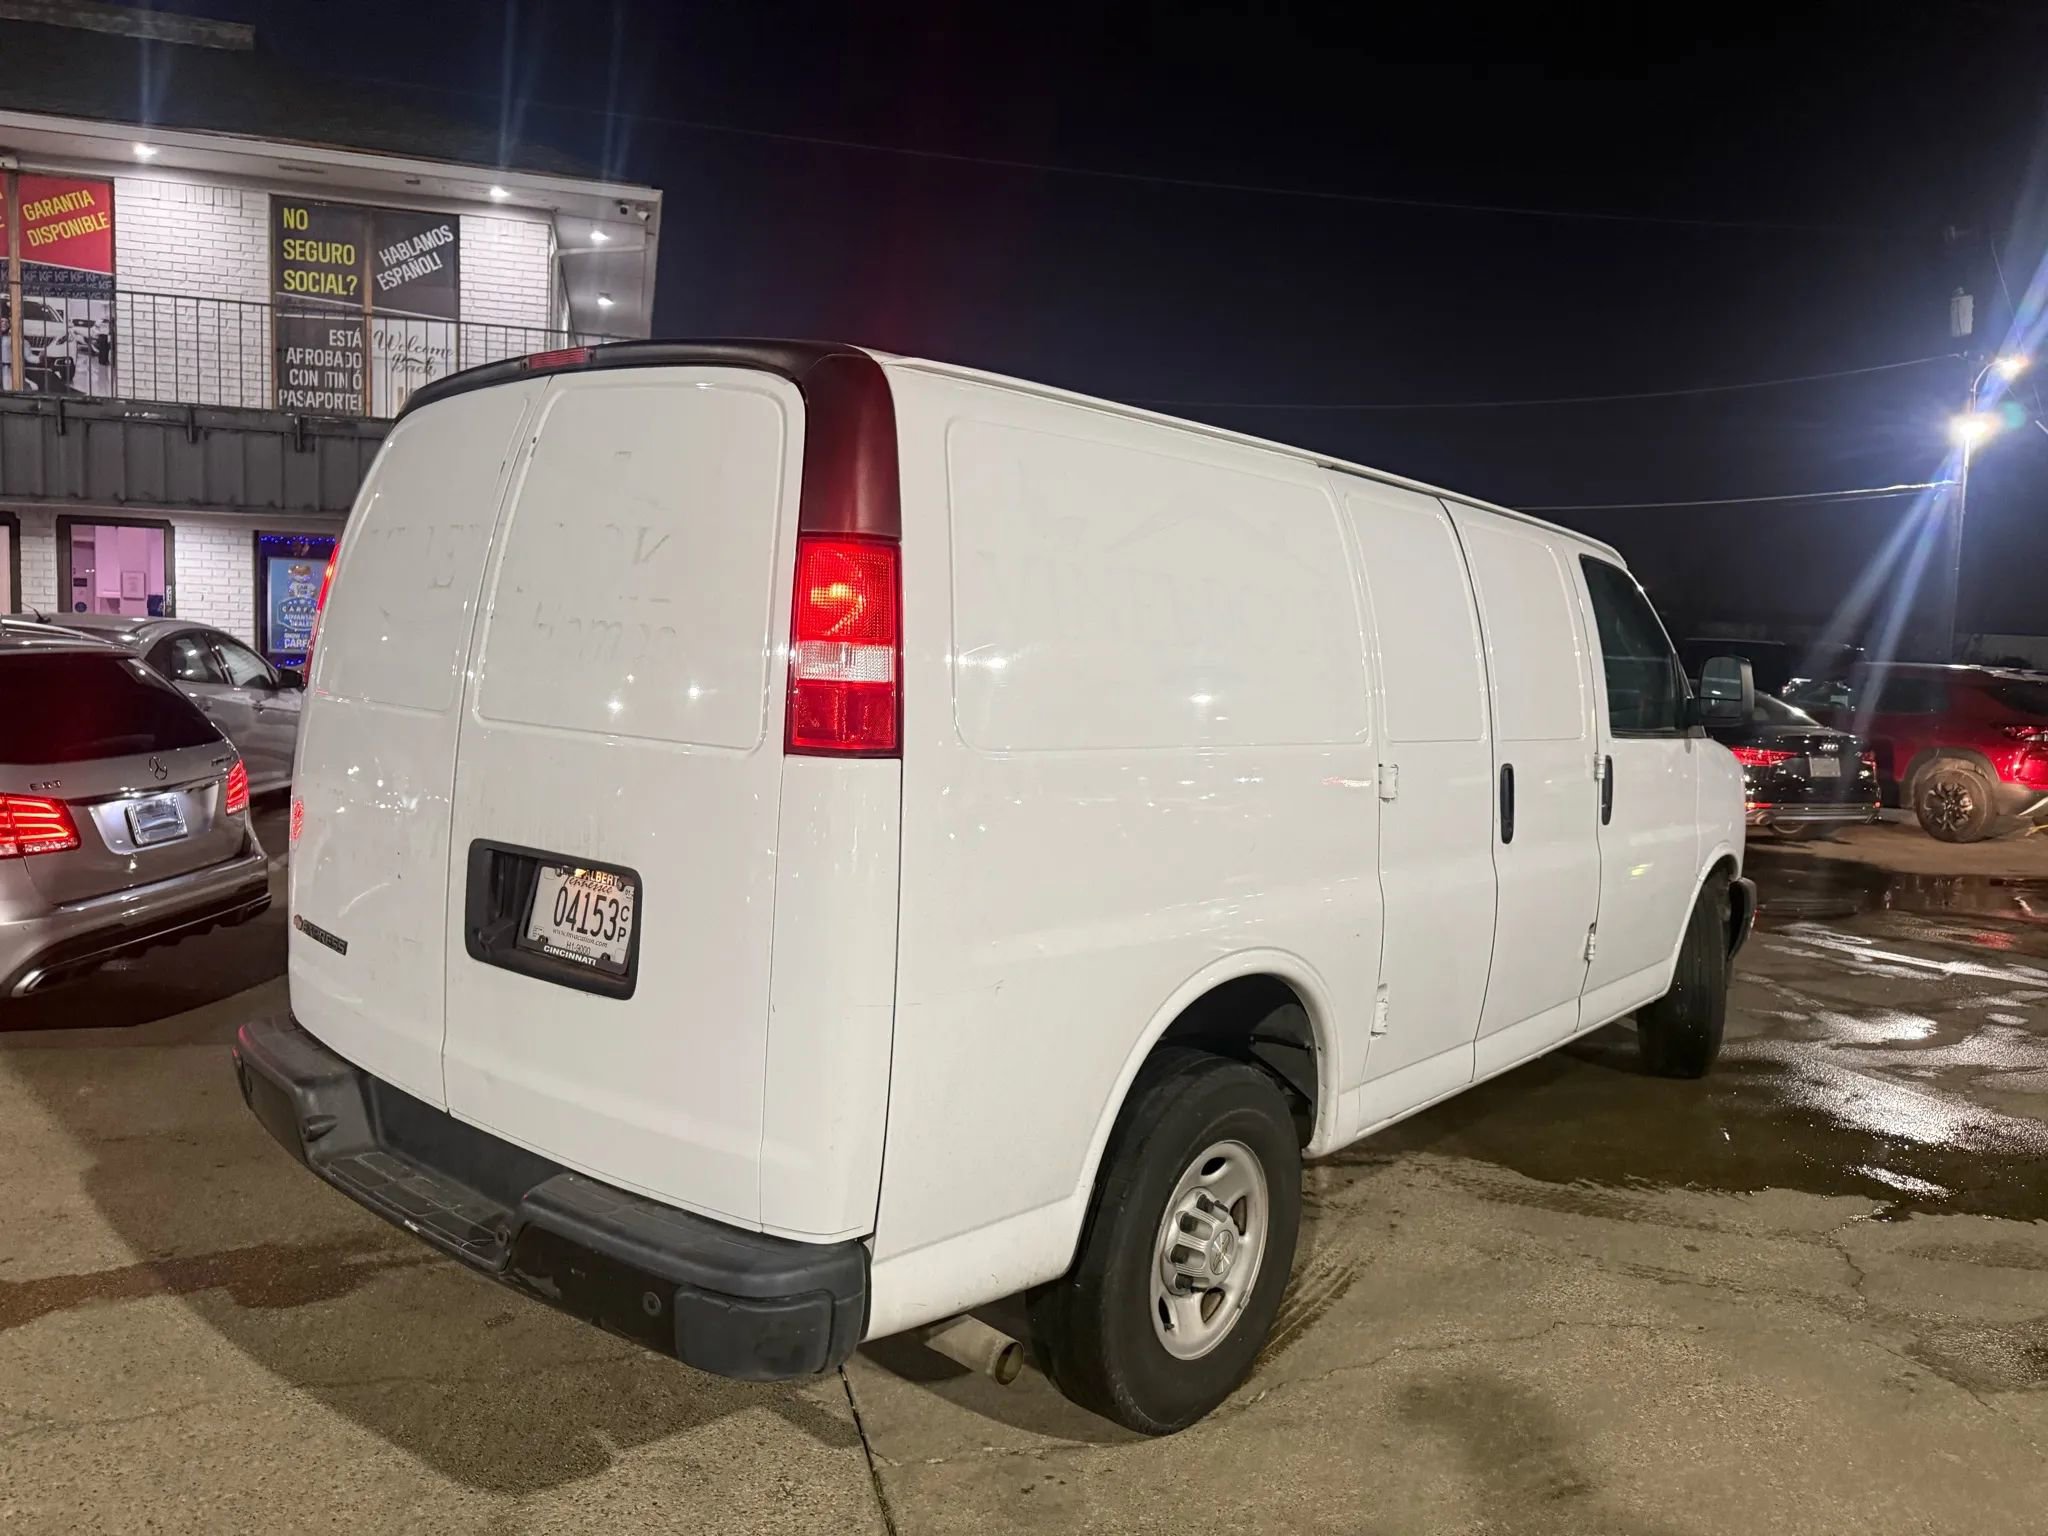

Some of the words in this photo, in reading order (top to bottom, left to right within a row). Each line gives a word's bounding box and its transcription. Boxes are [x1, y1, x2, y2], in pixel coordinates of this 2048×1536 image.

[22, 189, 95, 221] GARANTIA
[26, 212, 110, 247] DISPONIBLE
[283, 207, 308, 230] NO
[283, 238, 356, 266] SEGURO
[378, 225, 454, 267] HABLAMOS
[283, 269, 358, 295] SOCIAL?
[376, 251, 443, 291] ESPAÑOL!
[329, 327, 363, 348] ESTÁ
[289, 368, 318, 388] CON
[278, 388, 363, 412] PASAPORTE!
[281, 605, 315, 613] CARFA
[284, 638, 309, 649] CARF
[553, 886, 620, 941] 04153
[543, 944, 597, 967] CINCINNATI
